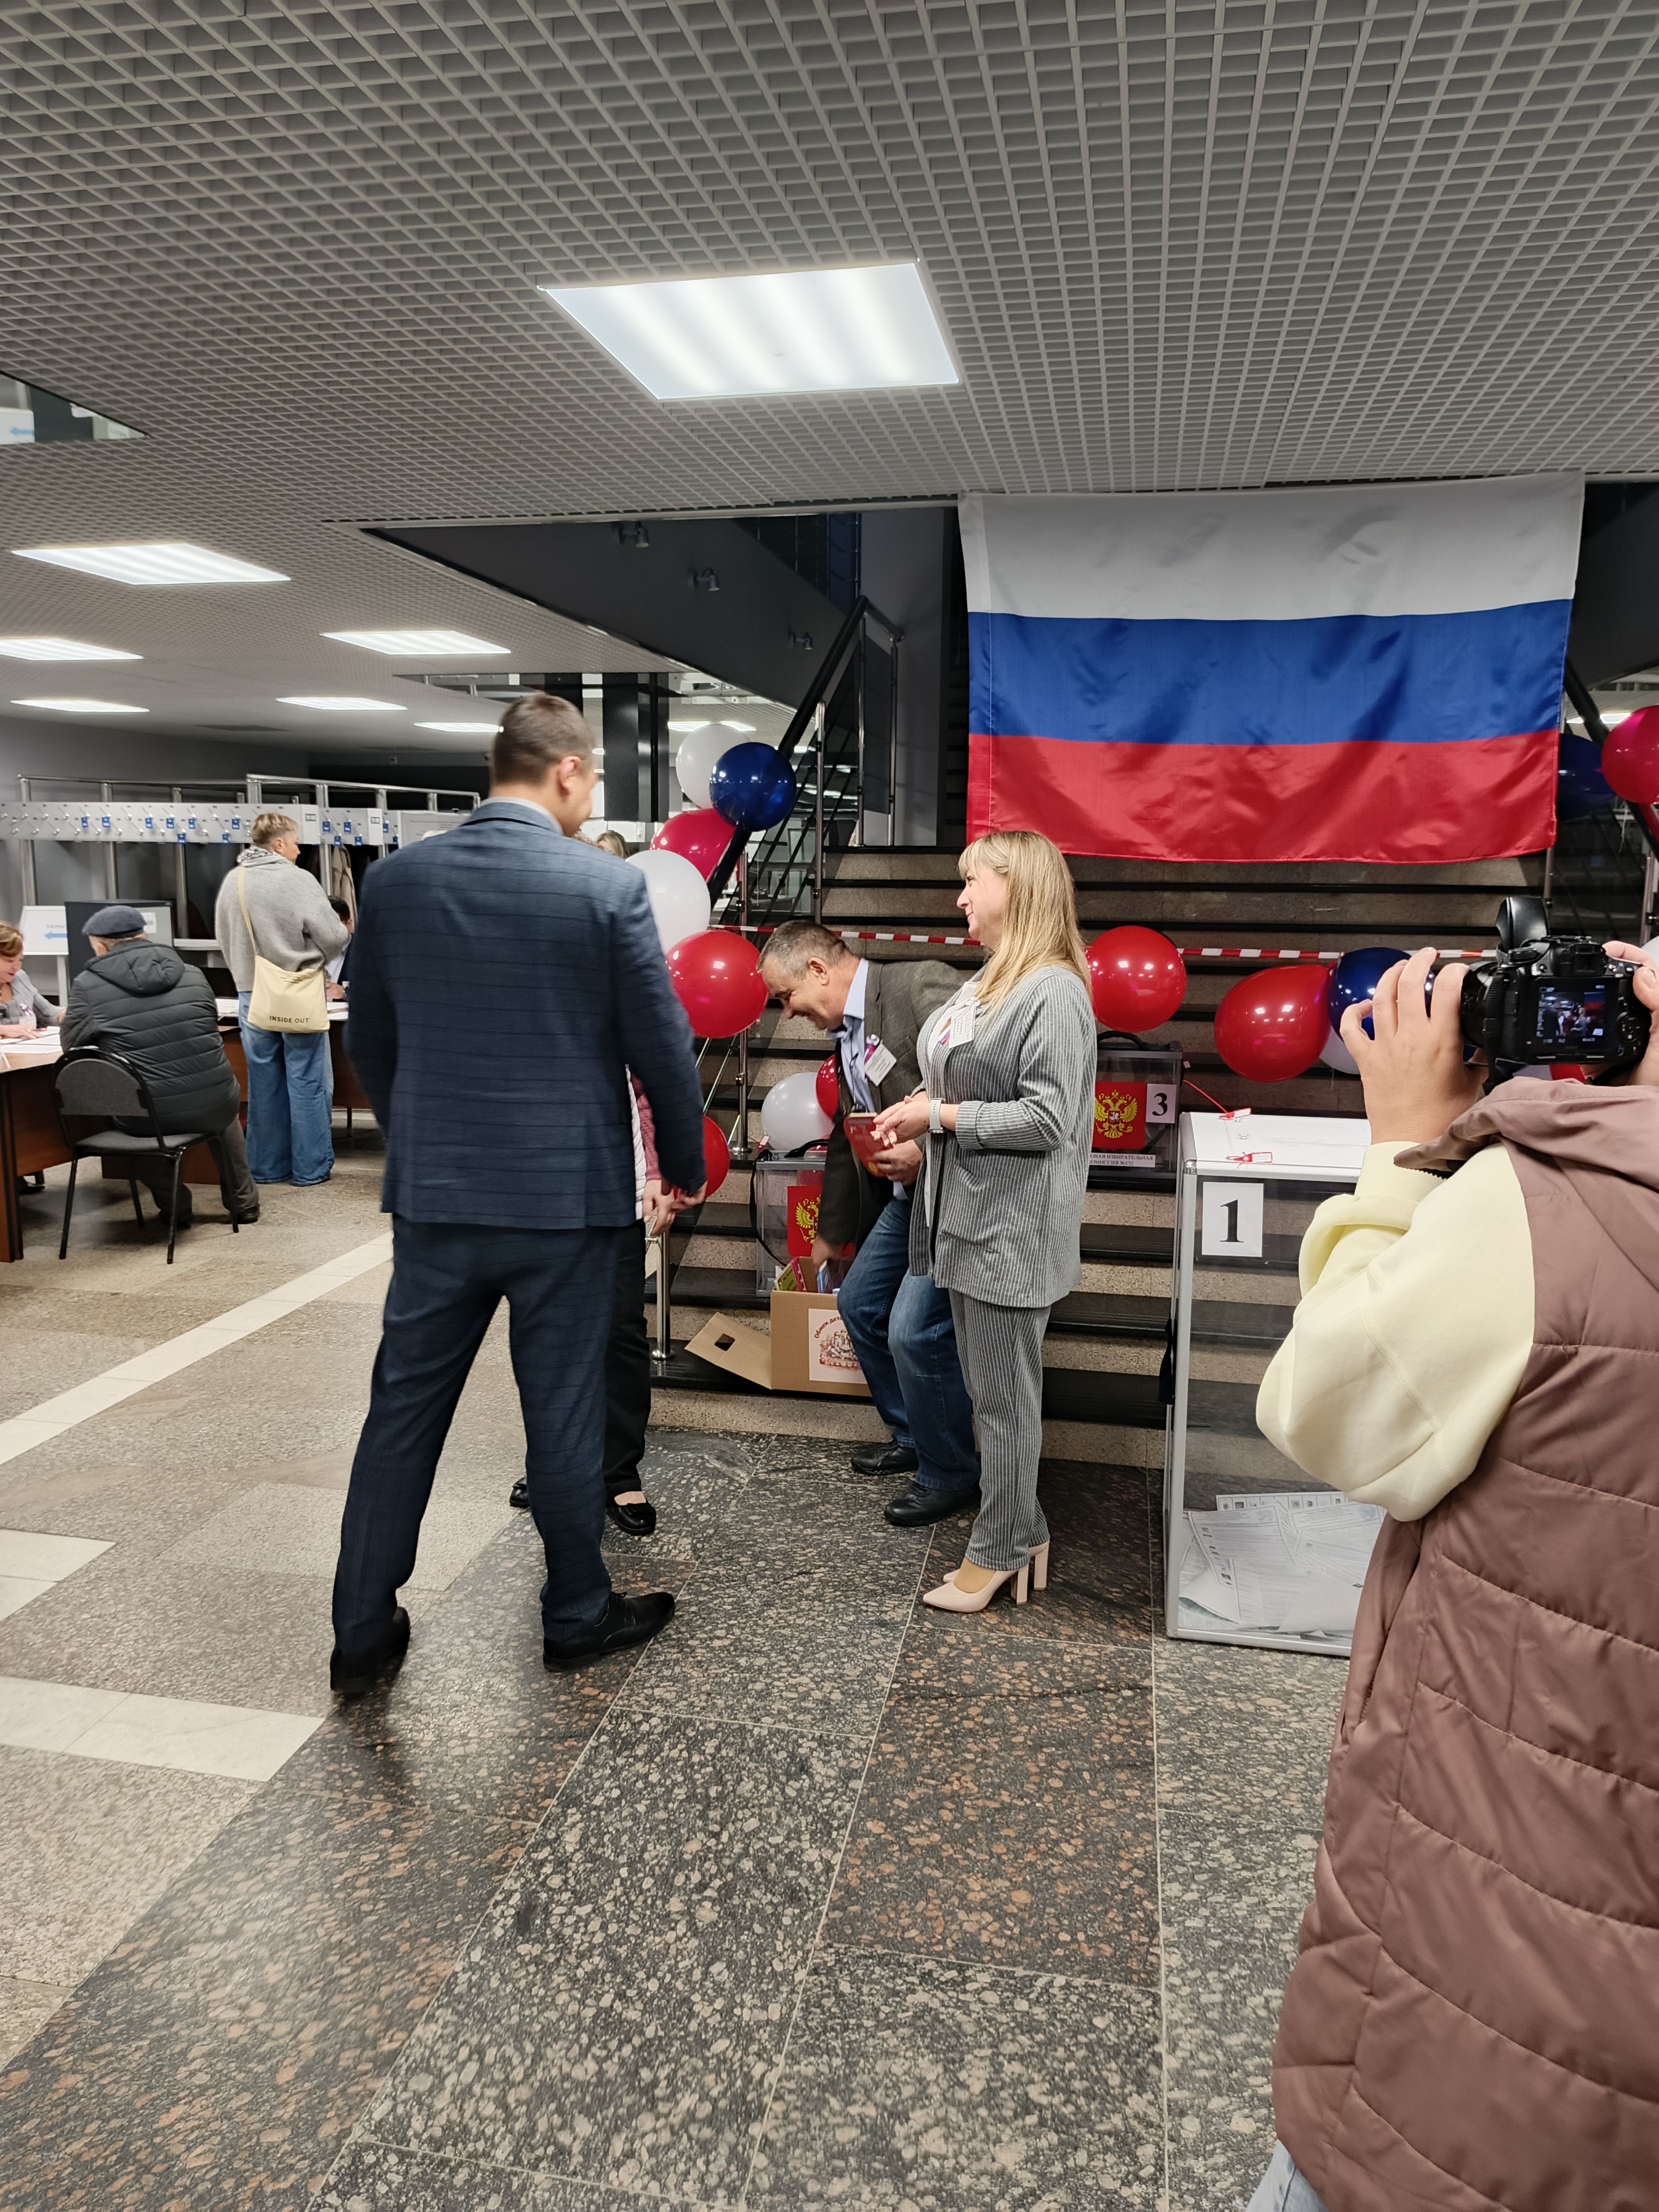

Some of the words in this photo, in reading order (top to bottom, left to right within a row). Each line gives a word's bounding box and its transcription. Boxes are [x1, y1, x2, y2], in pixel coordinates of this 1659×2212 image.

[1152, 1092, 1168, 1116] 3
[1220, 1199, 1244, 1243] 1
[814, 1321, 829, 1338] Обмен
